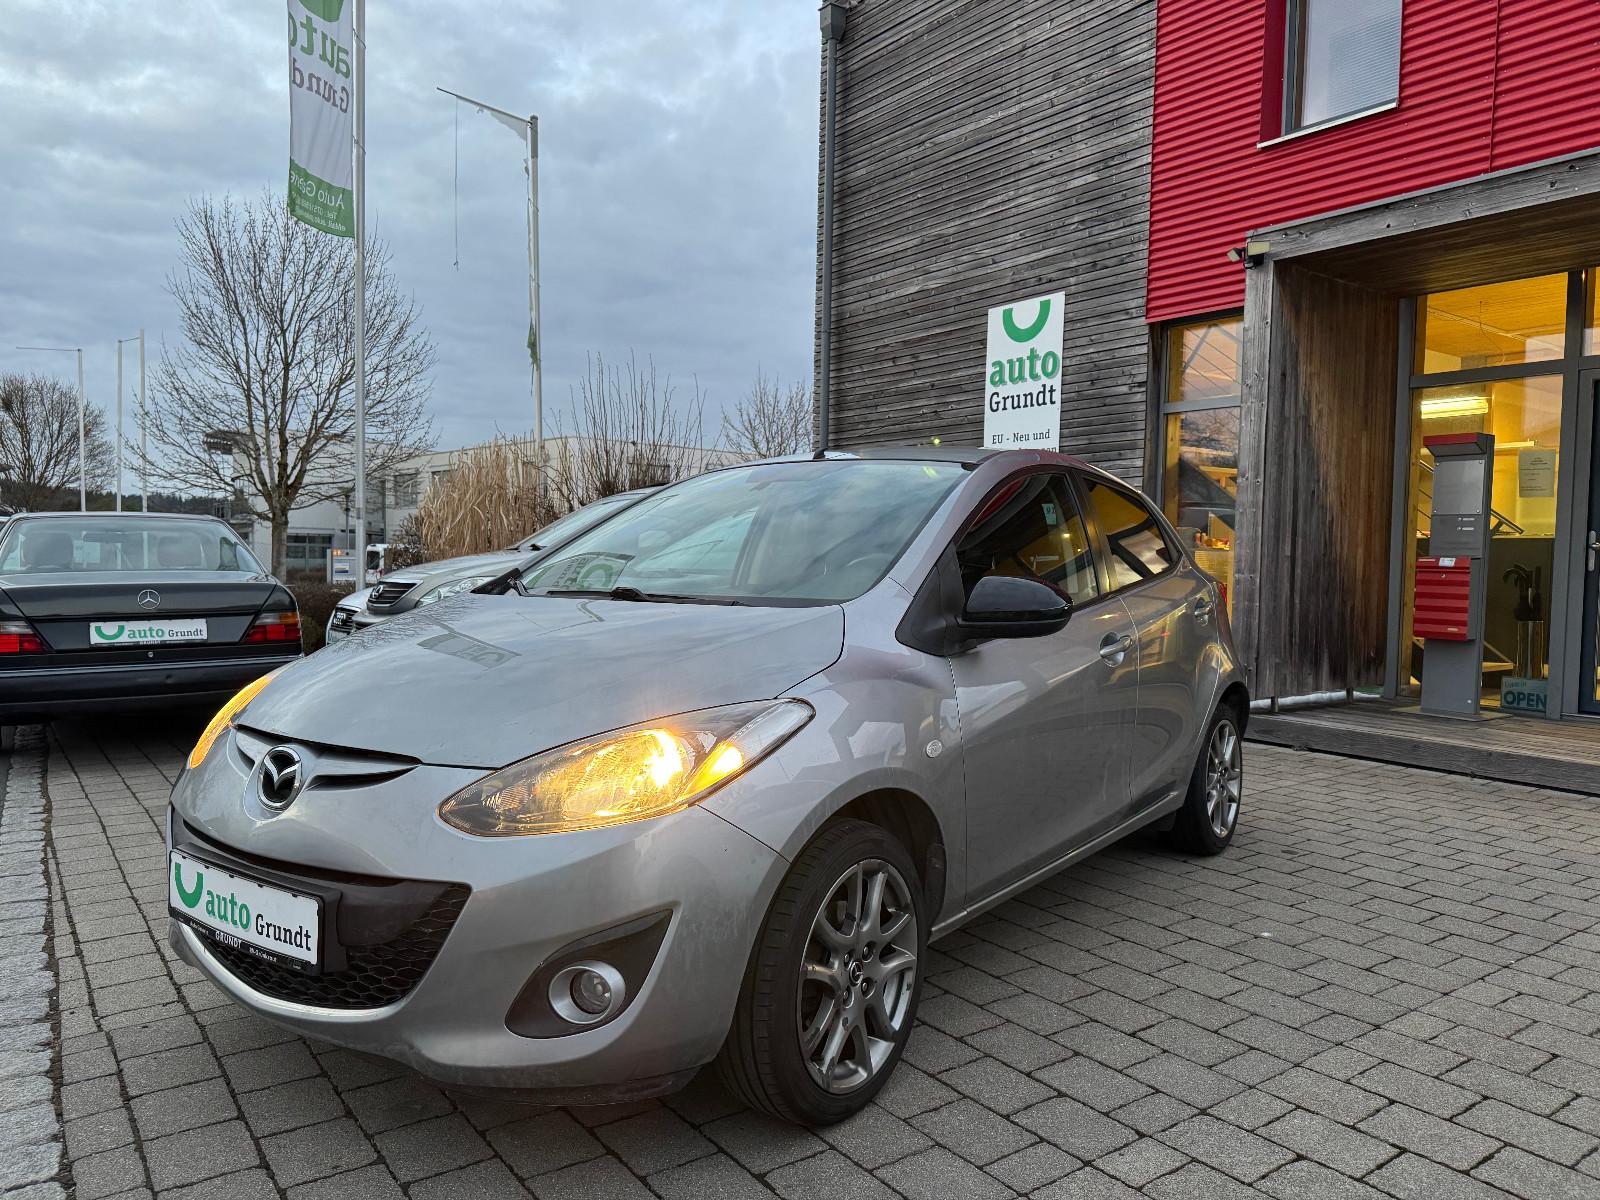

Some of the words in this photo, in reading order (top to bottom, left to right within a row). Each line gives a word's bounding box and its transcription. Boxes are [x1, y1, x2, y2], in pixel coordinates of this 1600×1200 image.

[989, 347, 1059, 387] auto
[989, 384, 1056, 412] Grundt
[992, 434, 1002, 444] EU
[1013, 431, 1030, 443] Neu
[1033, 429, 1050, 440] und
[127, 626, 165, 639] auto
[168, 628, 203, 637] Grundt
[1504, 691, 1547, 708] OPEN
[206, 890, 250, 930] auto
[255, 913, 312, 951] Grundt
[215, 931, 242, 949] GRUNDT
